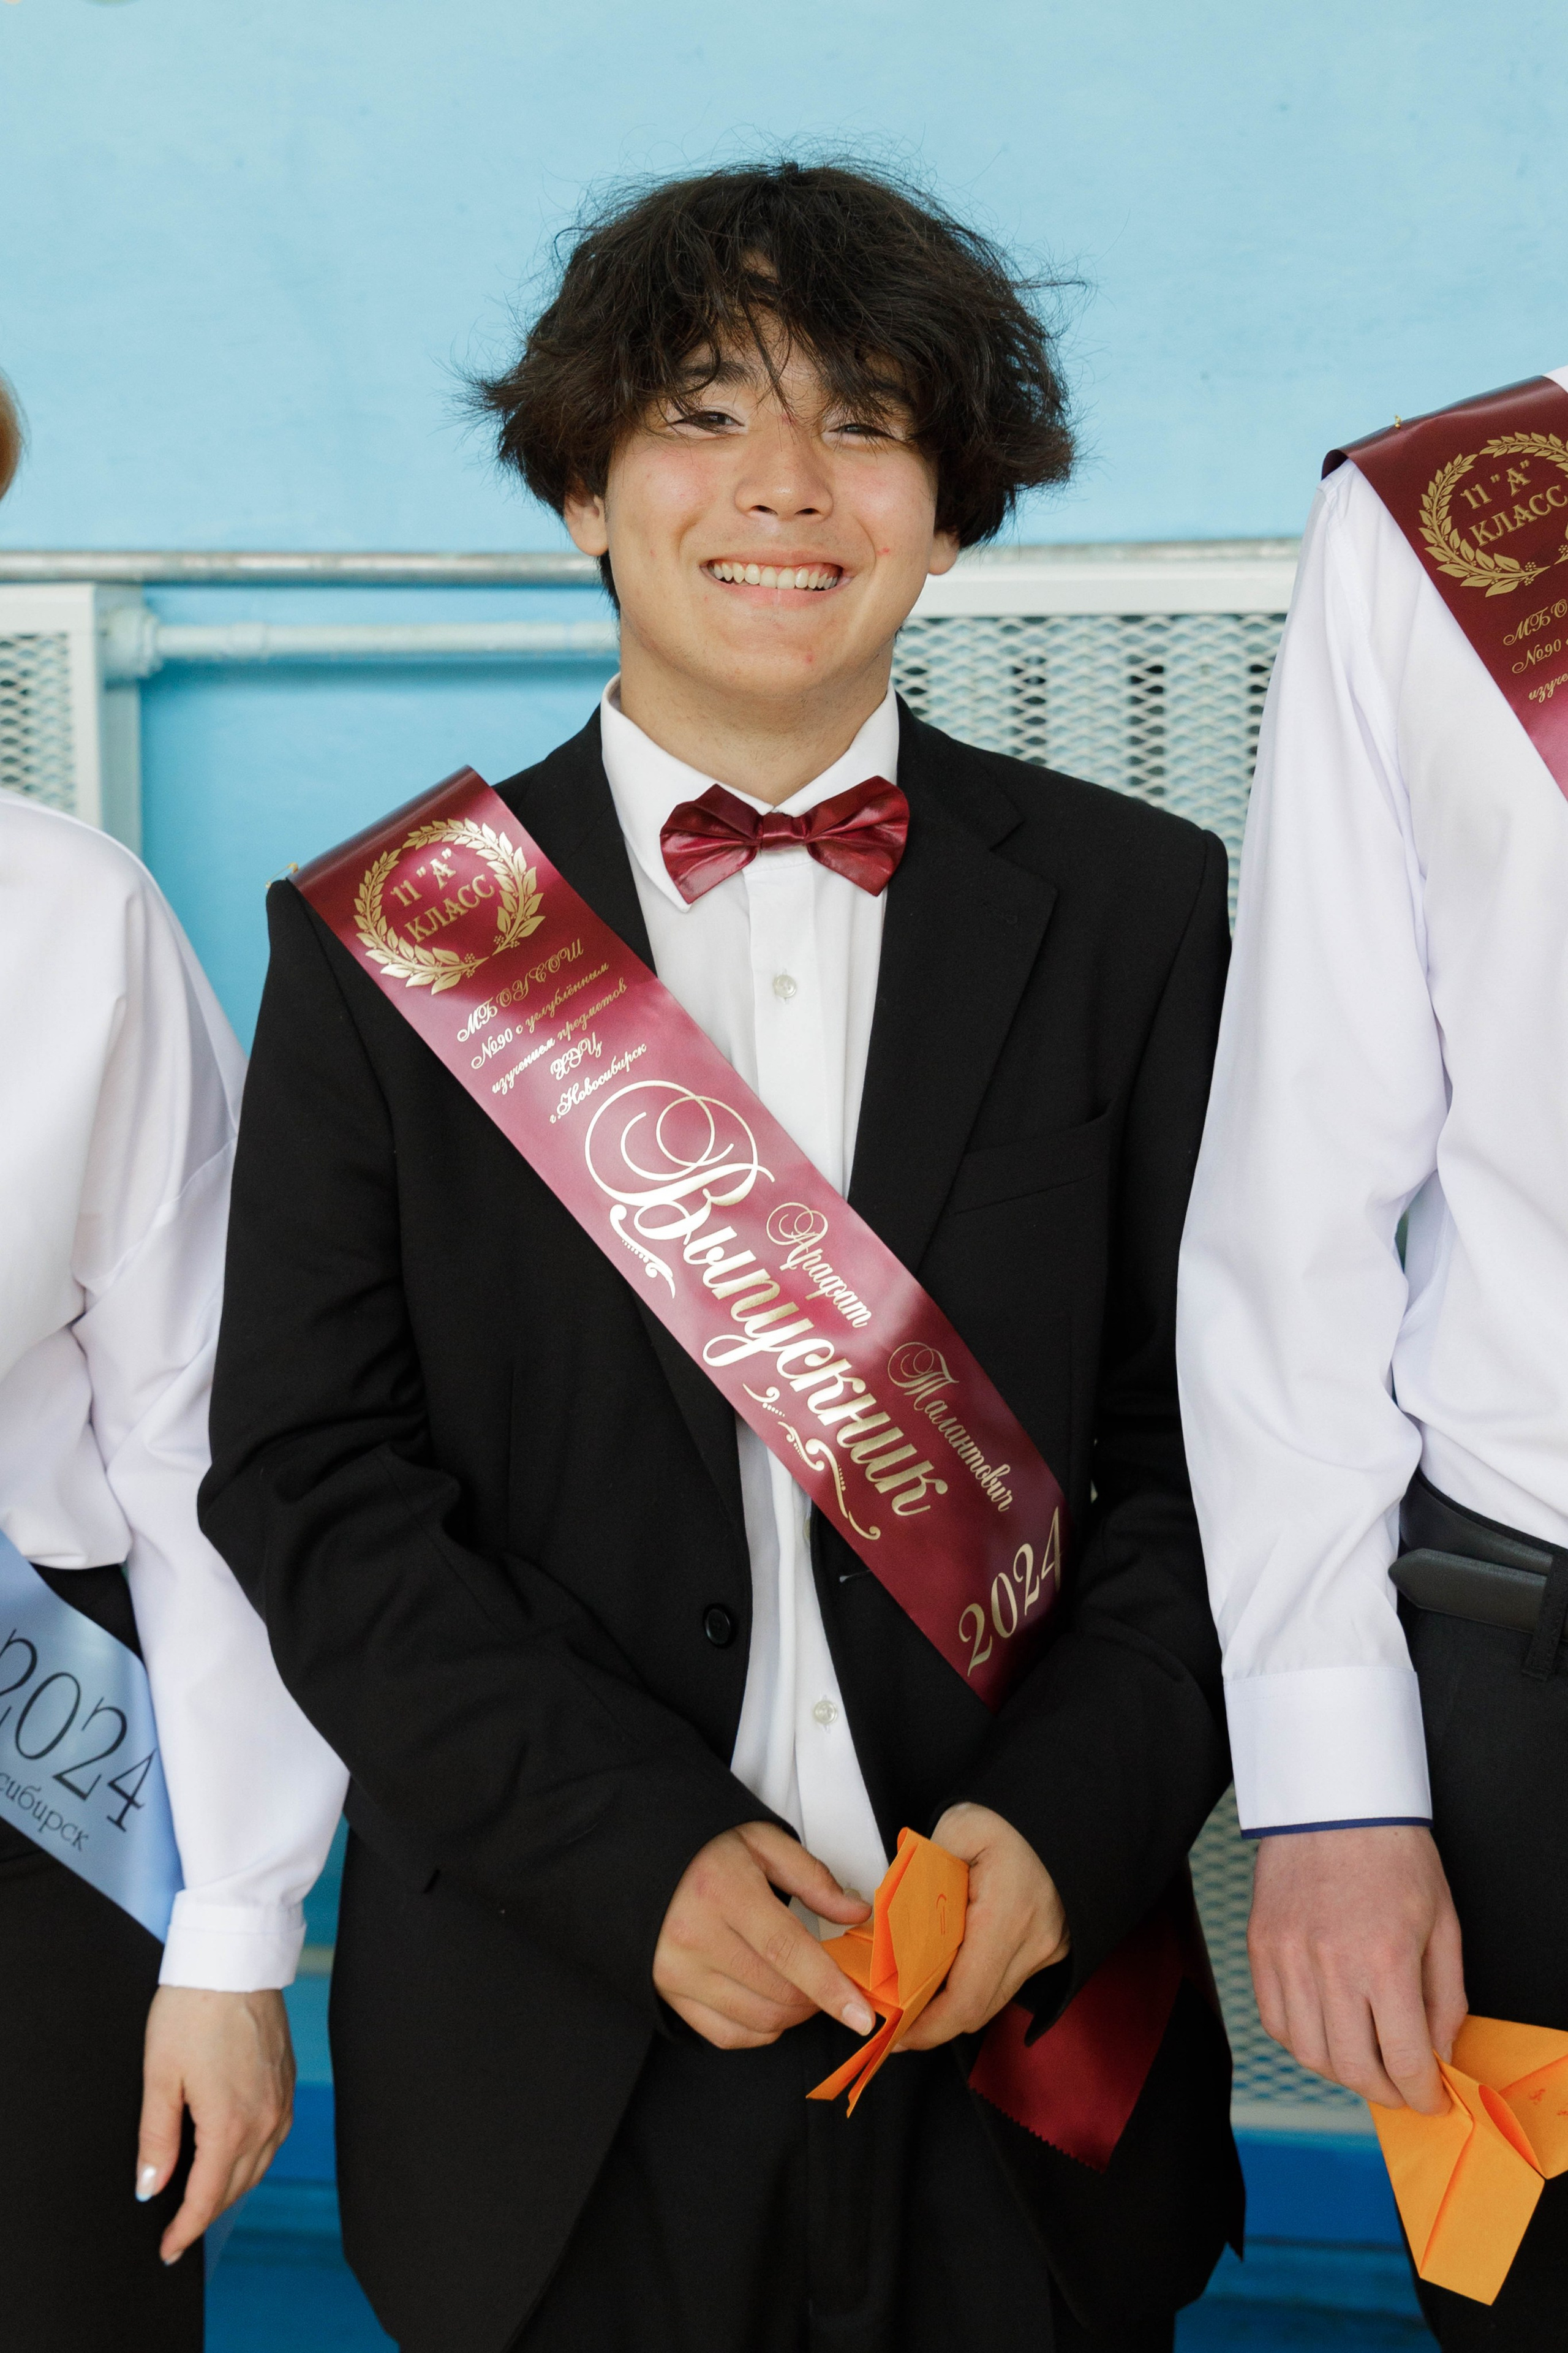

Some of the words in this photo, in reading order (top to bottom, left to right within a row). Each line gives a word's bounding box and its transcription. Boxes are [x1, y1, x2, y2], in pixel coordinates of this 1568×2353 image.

[1459, 480, 1492, 510] 11
[1469, 485, 1567, 548] КЛАСС
[1512, 638, 1561, 674] №90
[390, 880, 423, 907] 11
[404, 874, 495, 943] КЛАСС
[470, 1027, 513, 1070] №90
[525, 962, 609, 1034] углублённым
[491, 1037, 556, 1095] изучением
[557, 976, 628, 1041] предметов
[584, 1079, 948, 1517] Выпускник
[766, 1201, 872, 1329] Арафат
[887, 1341, 1014, 1513] Талантович
[958, 1506, 1063, 1677] 2024
